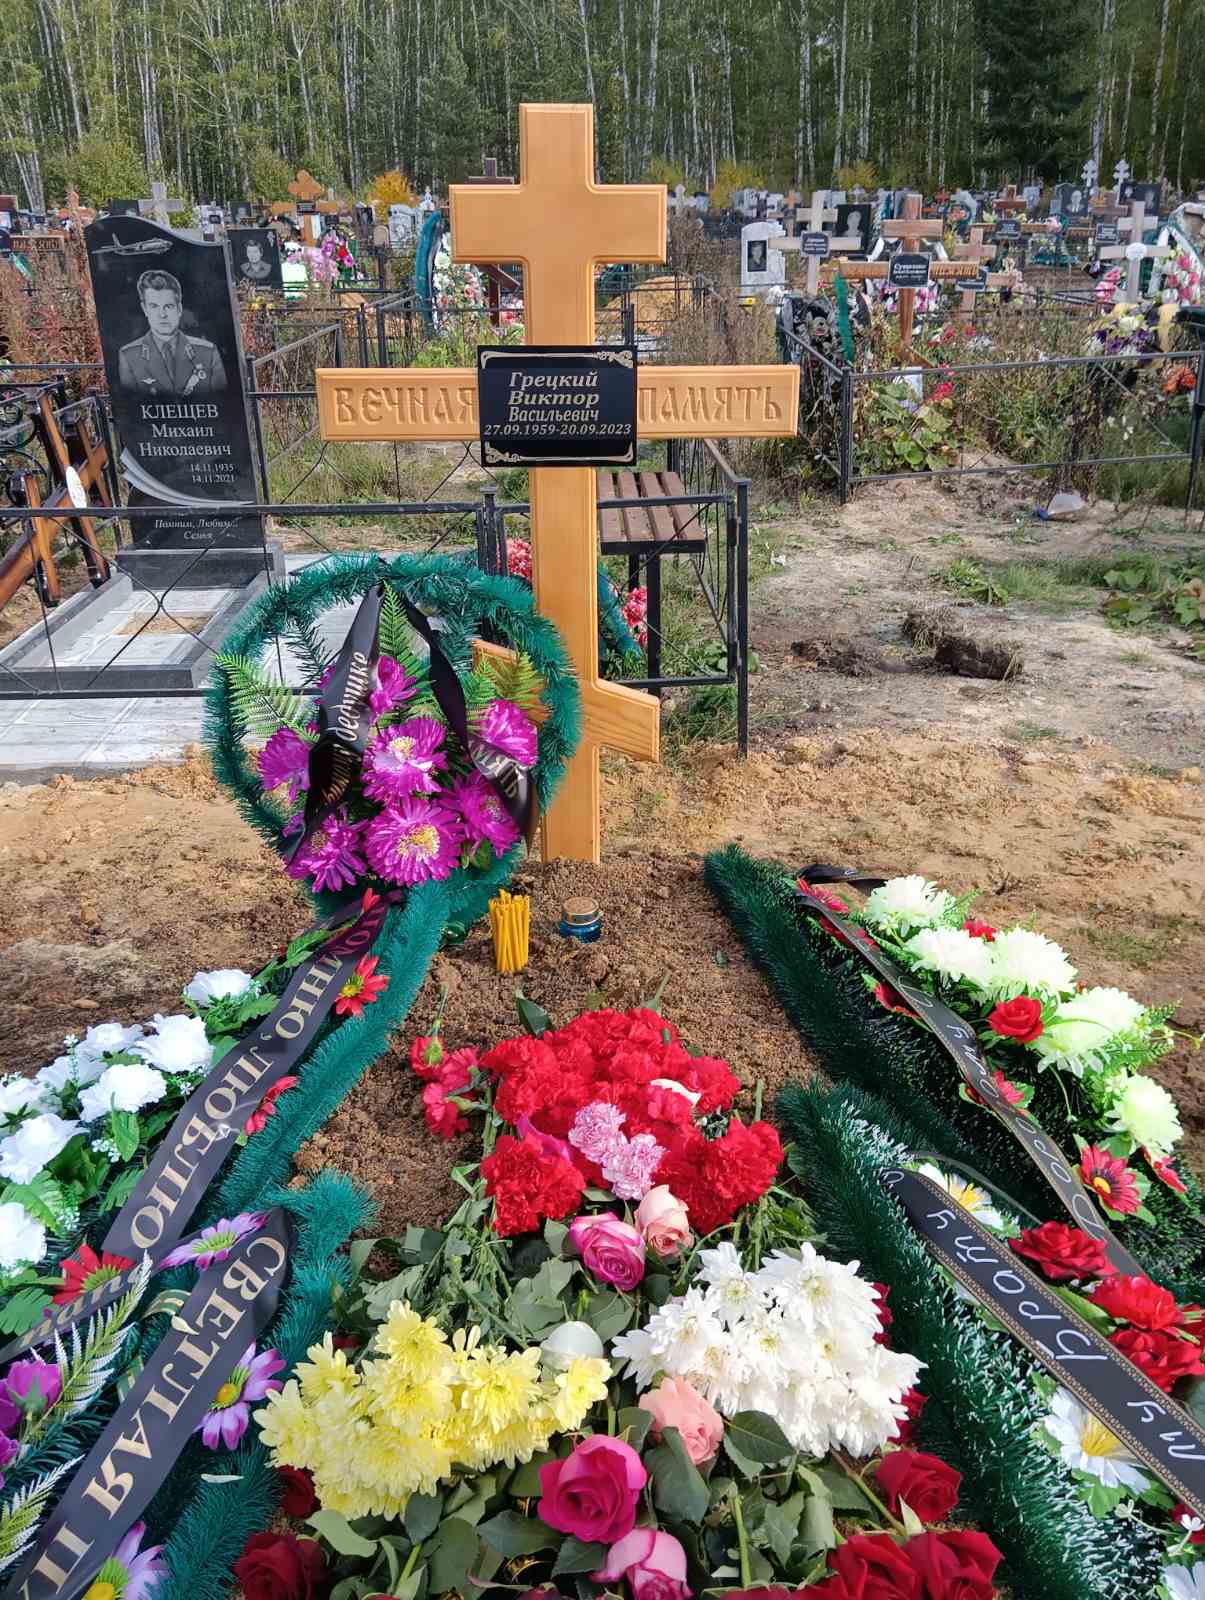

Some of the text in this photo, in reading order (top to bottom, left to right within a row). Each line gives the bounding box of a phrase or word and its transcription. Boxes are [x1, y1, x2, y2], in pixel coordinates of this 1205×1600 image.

[509, 369, 598, 391] Грецкий
[508, 390, 600, 408] Виктор
[636, 384, 782, 424] ПАМЯТЬ
[141, 403, 219, 420] КЛЕЩЕВ
[508, 406, 599, 422] Васильевич
[151, 423, 214, 438] Михаил
[484, 423, 631, 436] 27.09.1959-20.09.2023
[138, 441, 232, 457] Николаевич
[325, 652, 369, 742] дедушке
[131, 1046, 275, 1249] ЛЮБЛЮ
[82, 1237, 286, 1520] СВЕТЛАЯ
